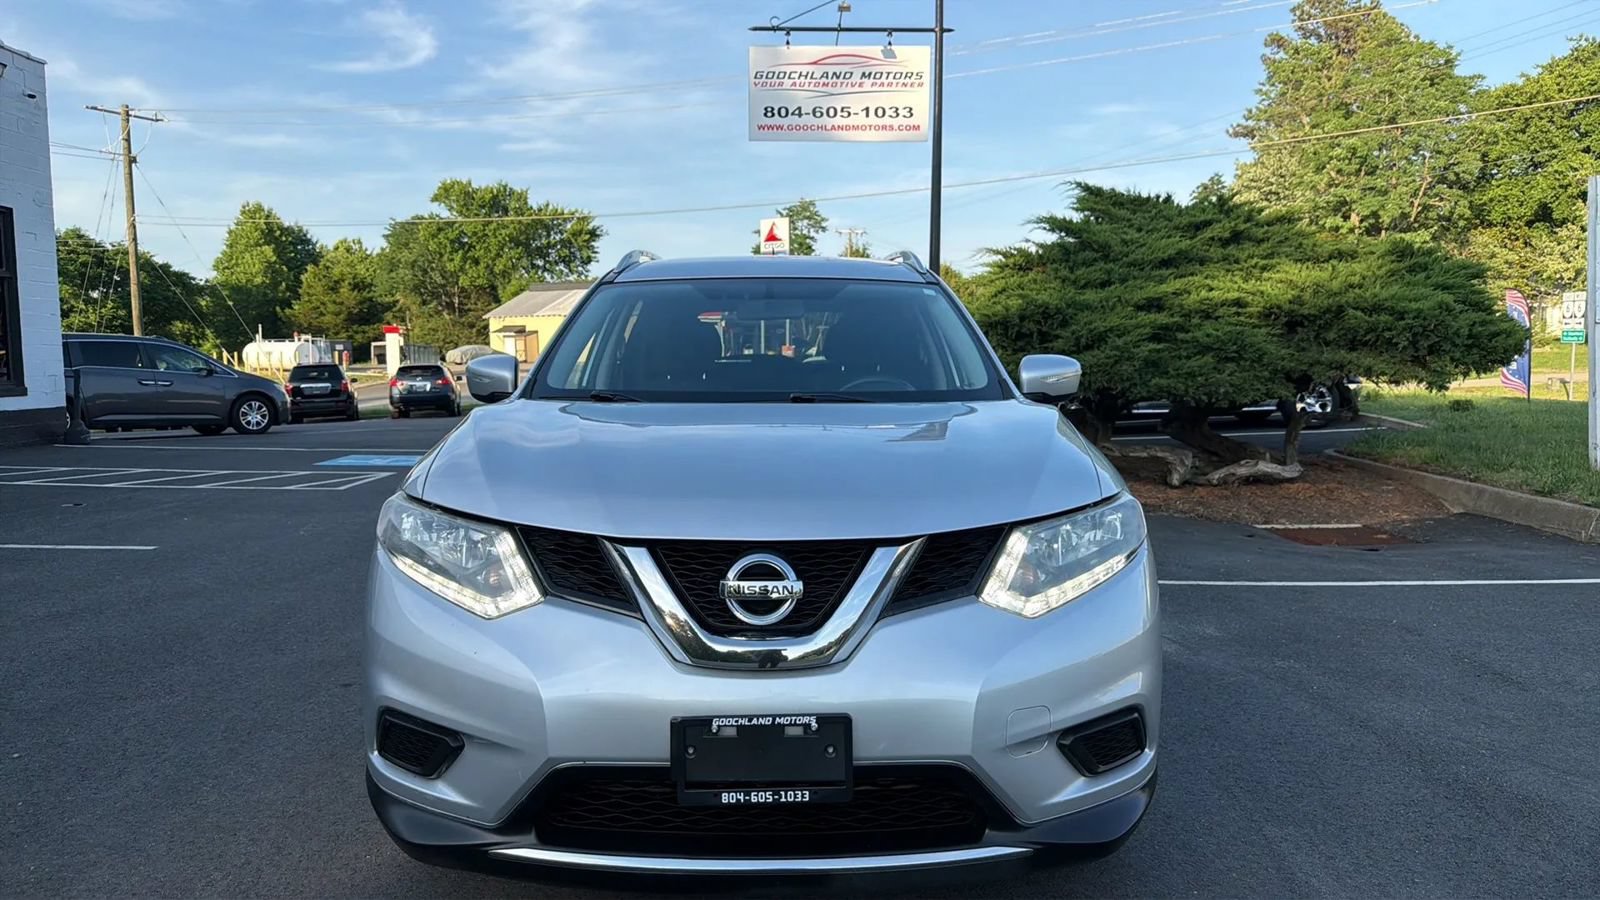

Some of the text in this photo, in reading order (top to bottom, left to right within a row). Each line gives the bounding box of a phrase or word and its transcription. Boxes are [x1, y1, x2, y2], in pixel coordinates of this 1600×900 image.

[753, 70, 924, 80] GOOCHLAND MOTORS
[763, 106, 914, 119] 804-605-1033
[757, 124, 921, 132] WWW.GOOCHLANDMOTORS.COM
[728, 584, 794, 595] NISSAN
[712, 716, 817, 726] GOOCHLAND MOTORS
[721, 791, 810, 803] 804-605-1033
